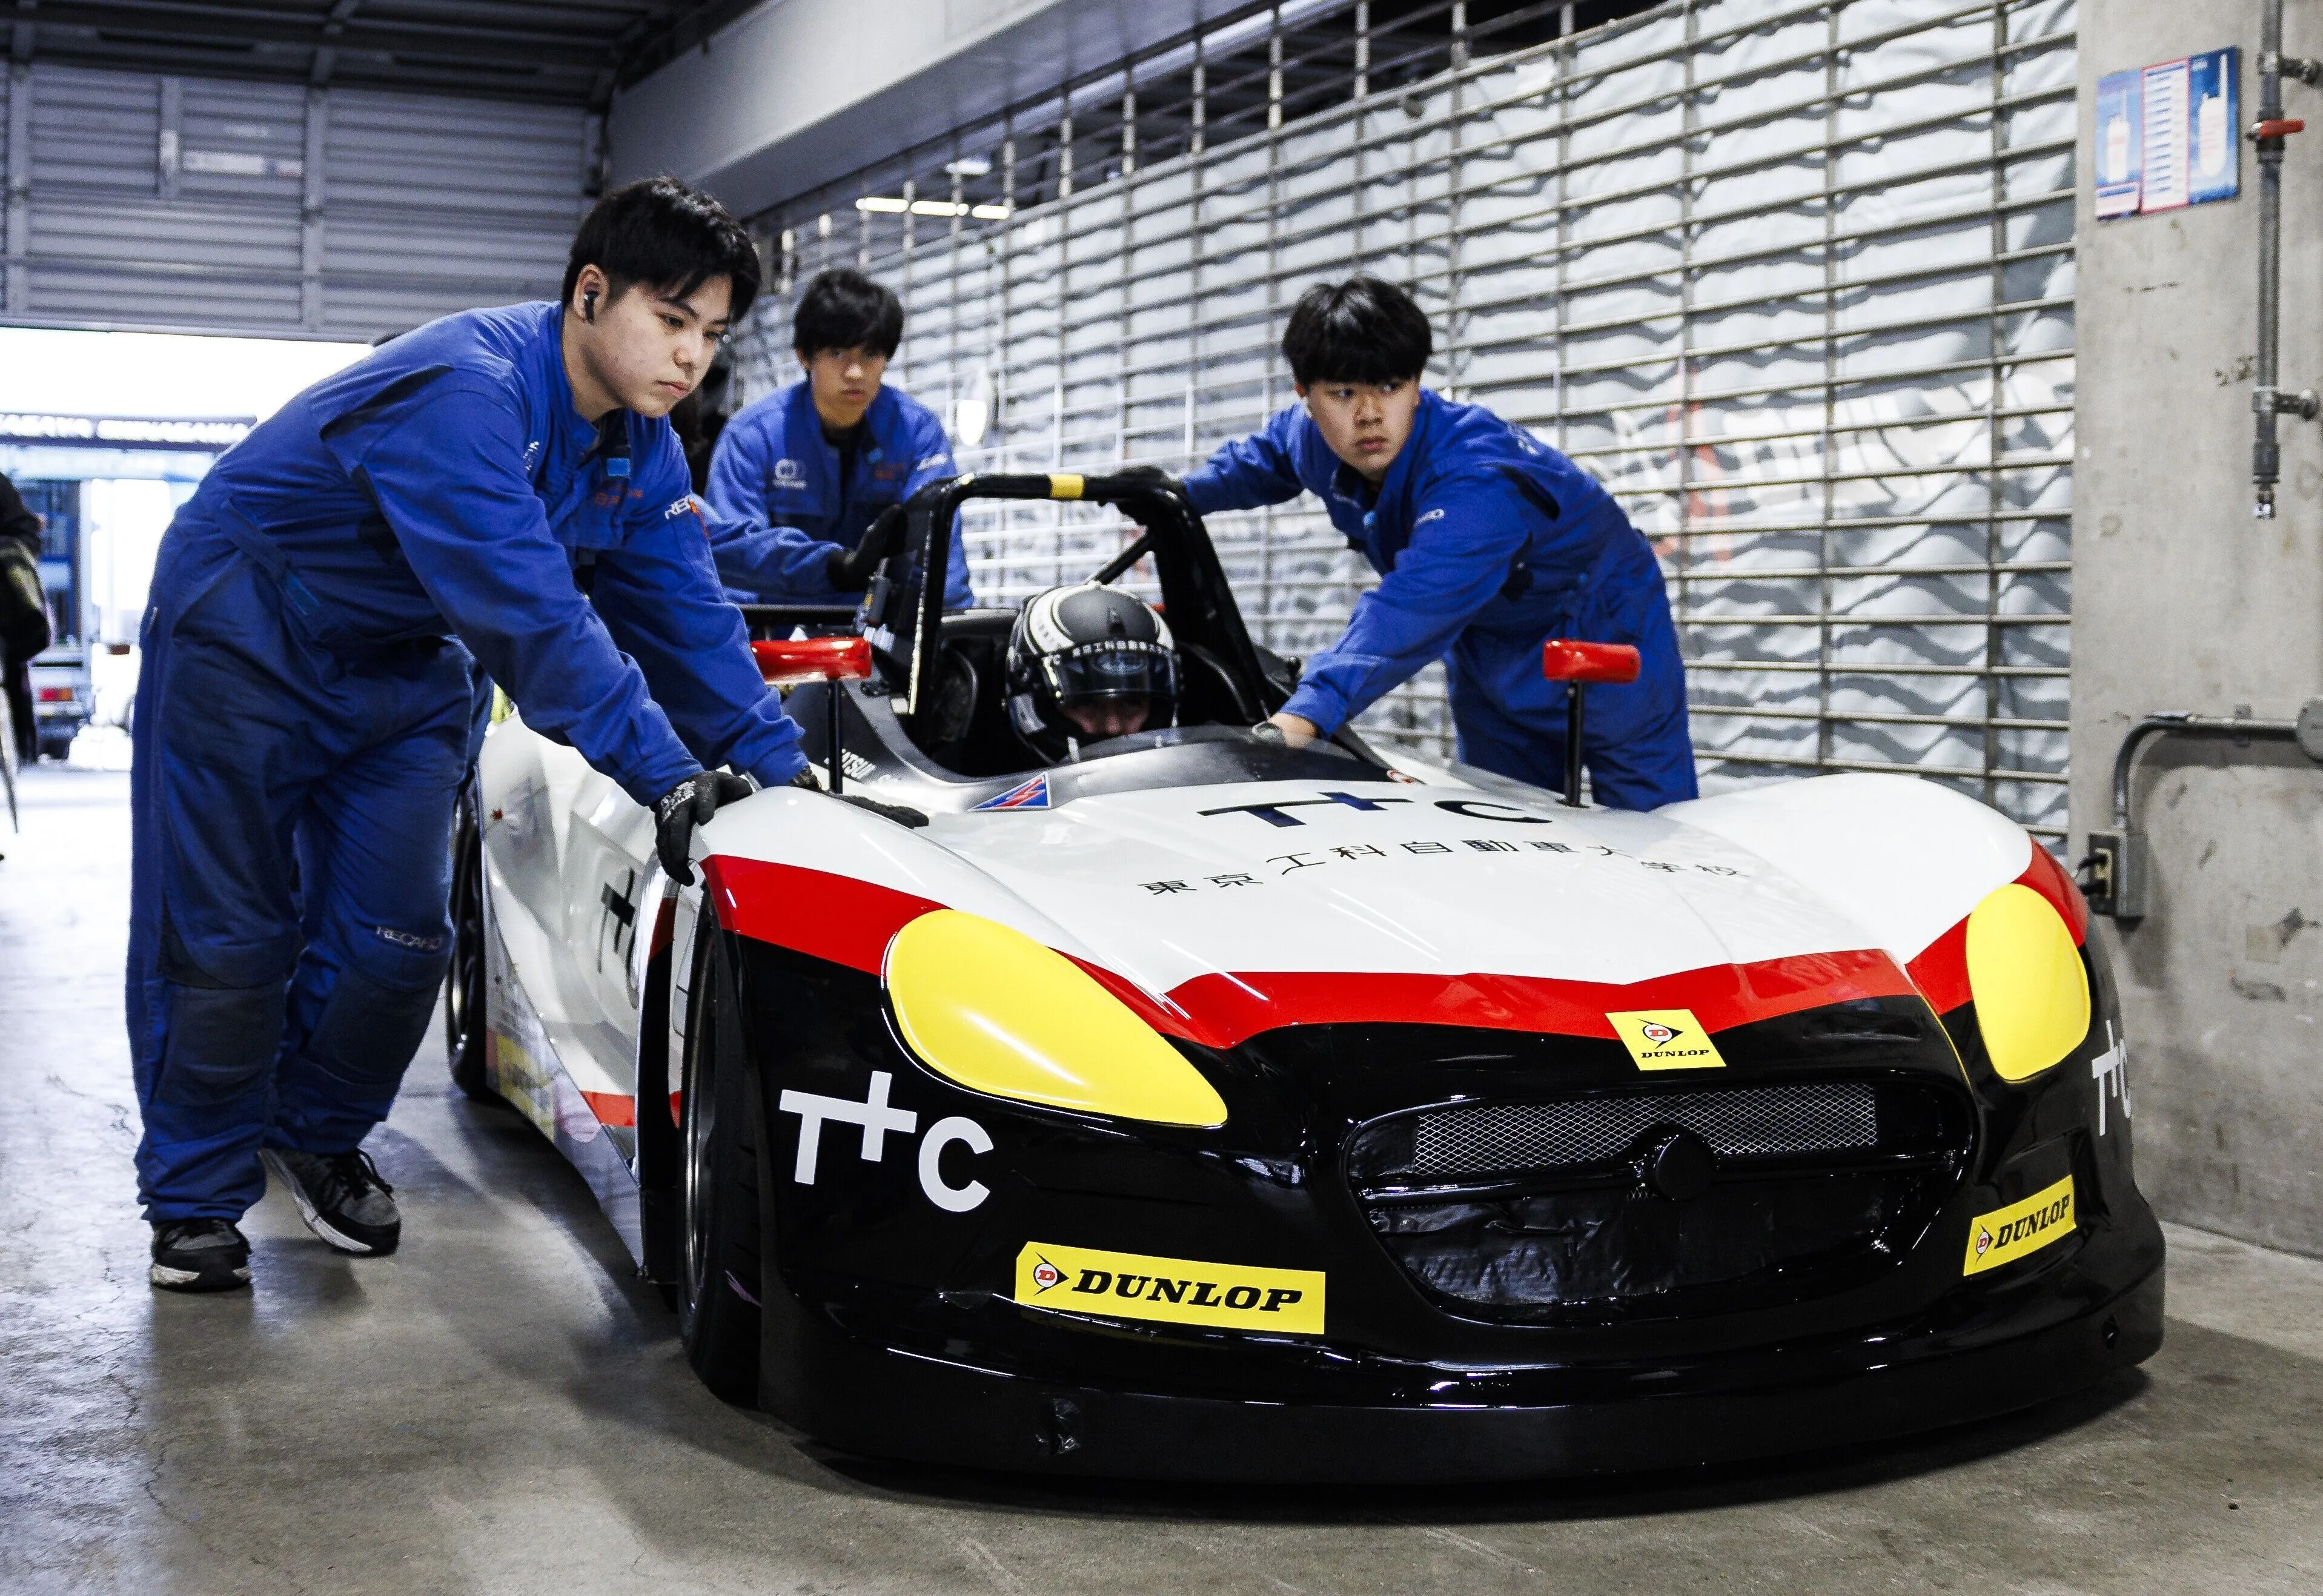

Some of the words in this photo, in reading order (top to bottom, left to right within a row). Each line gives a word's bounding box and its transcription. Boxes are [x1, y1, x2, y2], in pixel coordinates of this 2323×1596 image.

[1137, 838, 1751, 895] 東京工科自動車大学校
[1640, 1049, 1710, 1058] DUNLOP
[1993, 1193, 2070, 1250] DUNLOP
[1071, 1268, 1303, 1313] DUNLOP
